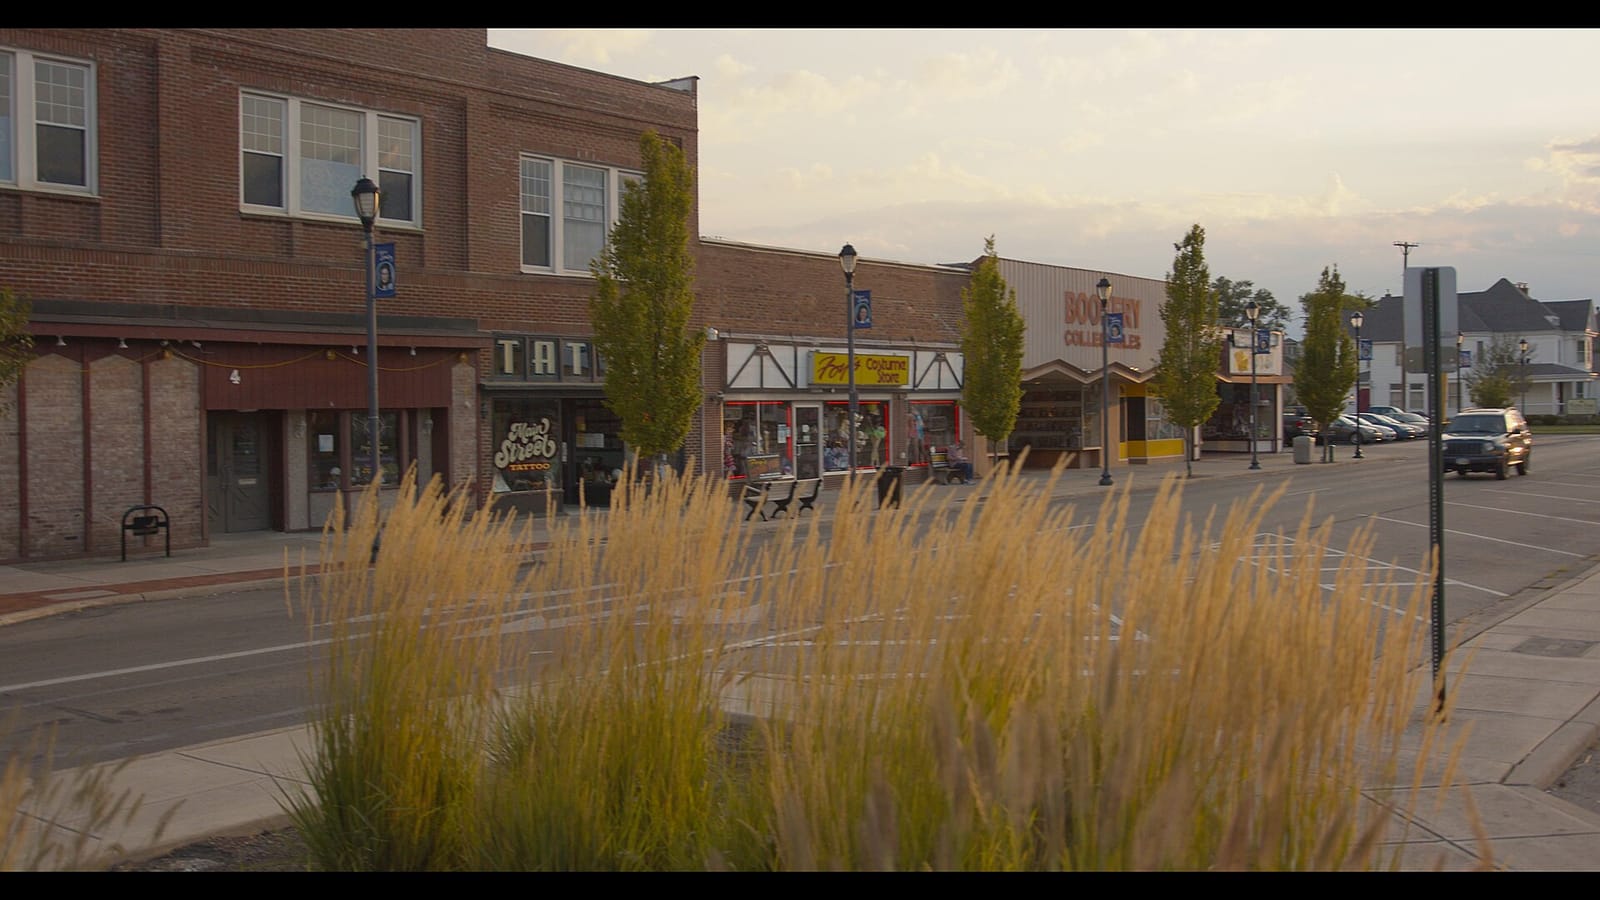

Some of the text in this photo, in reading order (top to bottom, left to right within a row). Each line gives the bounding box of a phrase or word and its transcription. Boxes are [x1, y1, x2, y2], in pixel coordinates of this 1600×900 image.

[1064, 291, 1140, 328] BOOERY
[866, 358, 906, 371] Costume
[877, 369, 900, 384] Store
[508, 417, 550, 443] Main
[494, 434, 557, 468] Street
[509, 463, 551, 471] TATTOO
